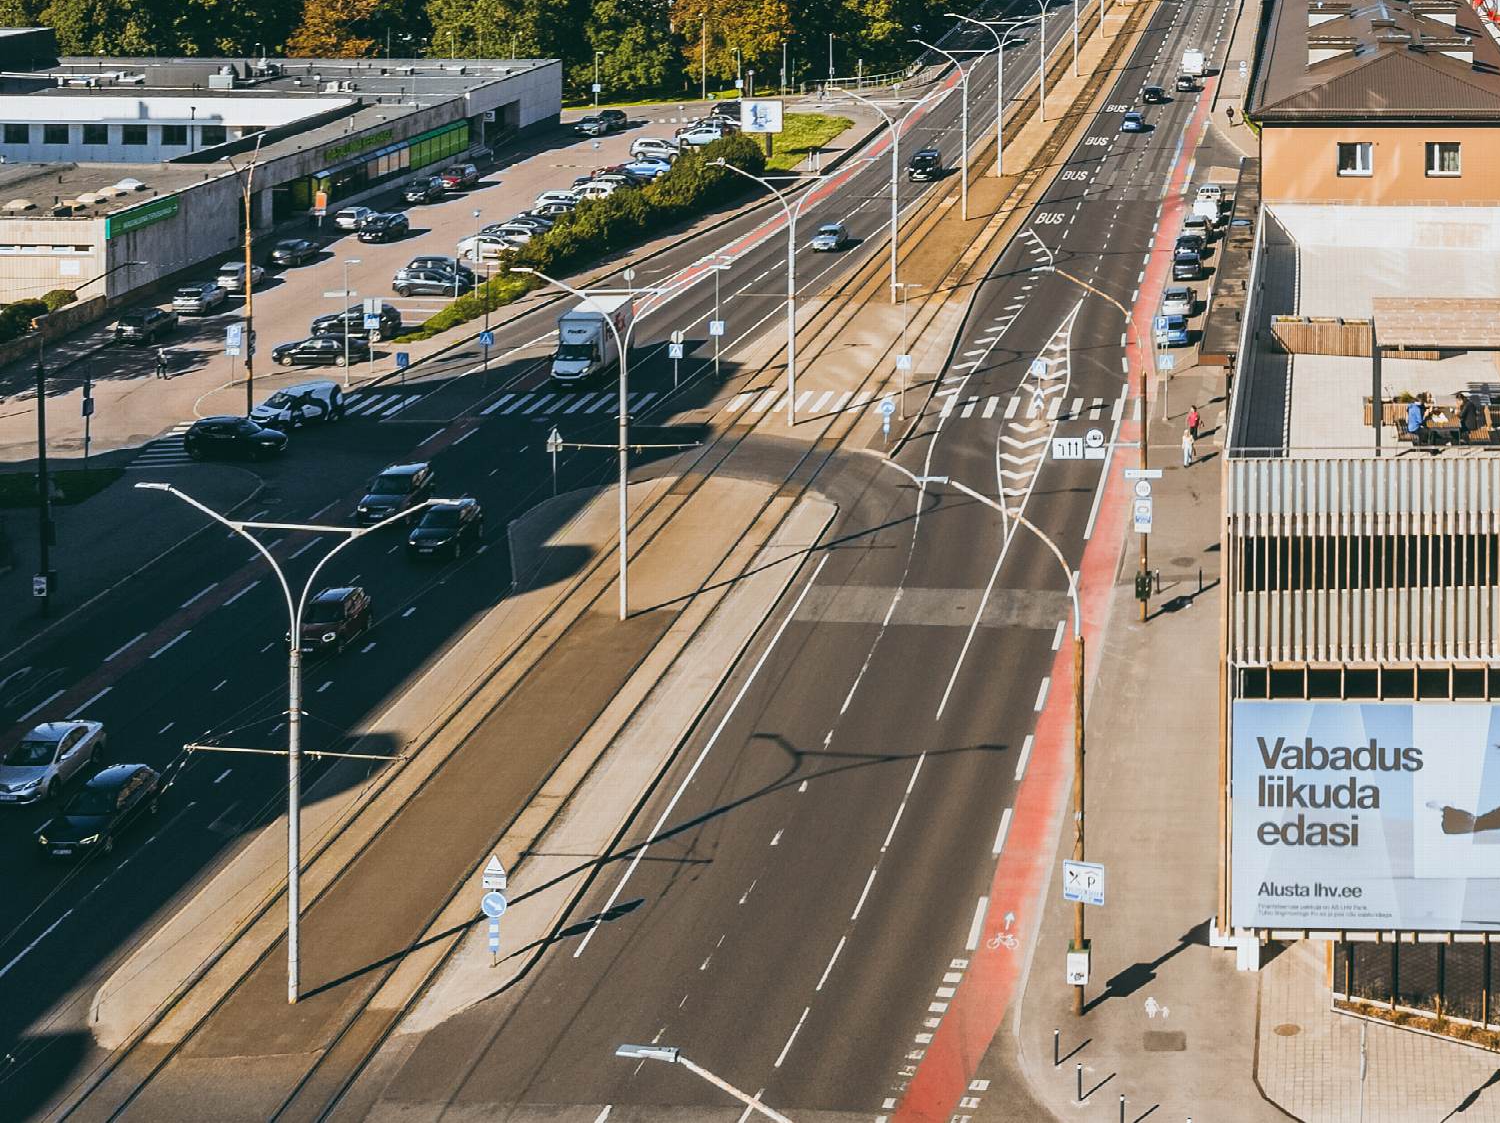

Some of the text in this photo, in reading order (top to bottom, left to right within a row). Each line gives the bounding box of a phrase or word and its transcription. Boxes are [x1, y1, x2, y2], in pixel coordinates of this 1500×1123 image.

[1105, 104, 1128, 112] BUS
[1085, 136, 1109, 146] BUS
[1061, 170, 1088, 181] BUS
[1034, 212, 1065, 224] BUS
[1257, 737, 1424, 772] Vabadus
[1258, 775, 1380, 809] liikuda
[1257, 814, 1359, 847] edasi
[1257, 881, 1362, 898] Alusta lhv.ee
